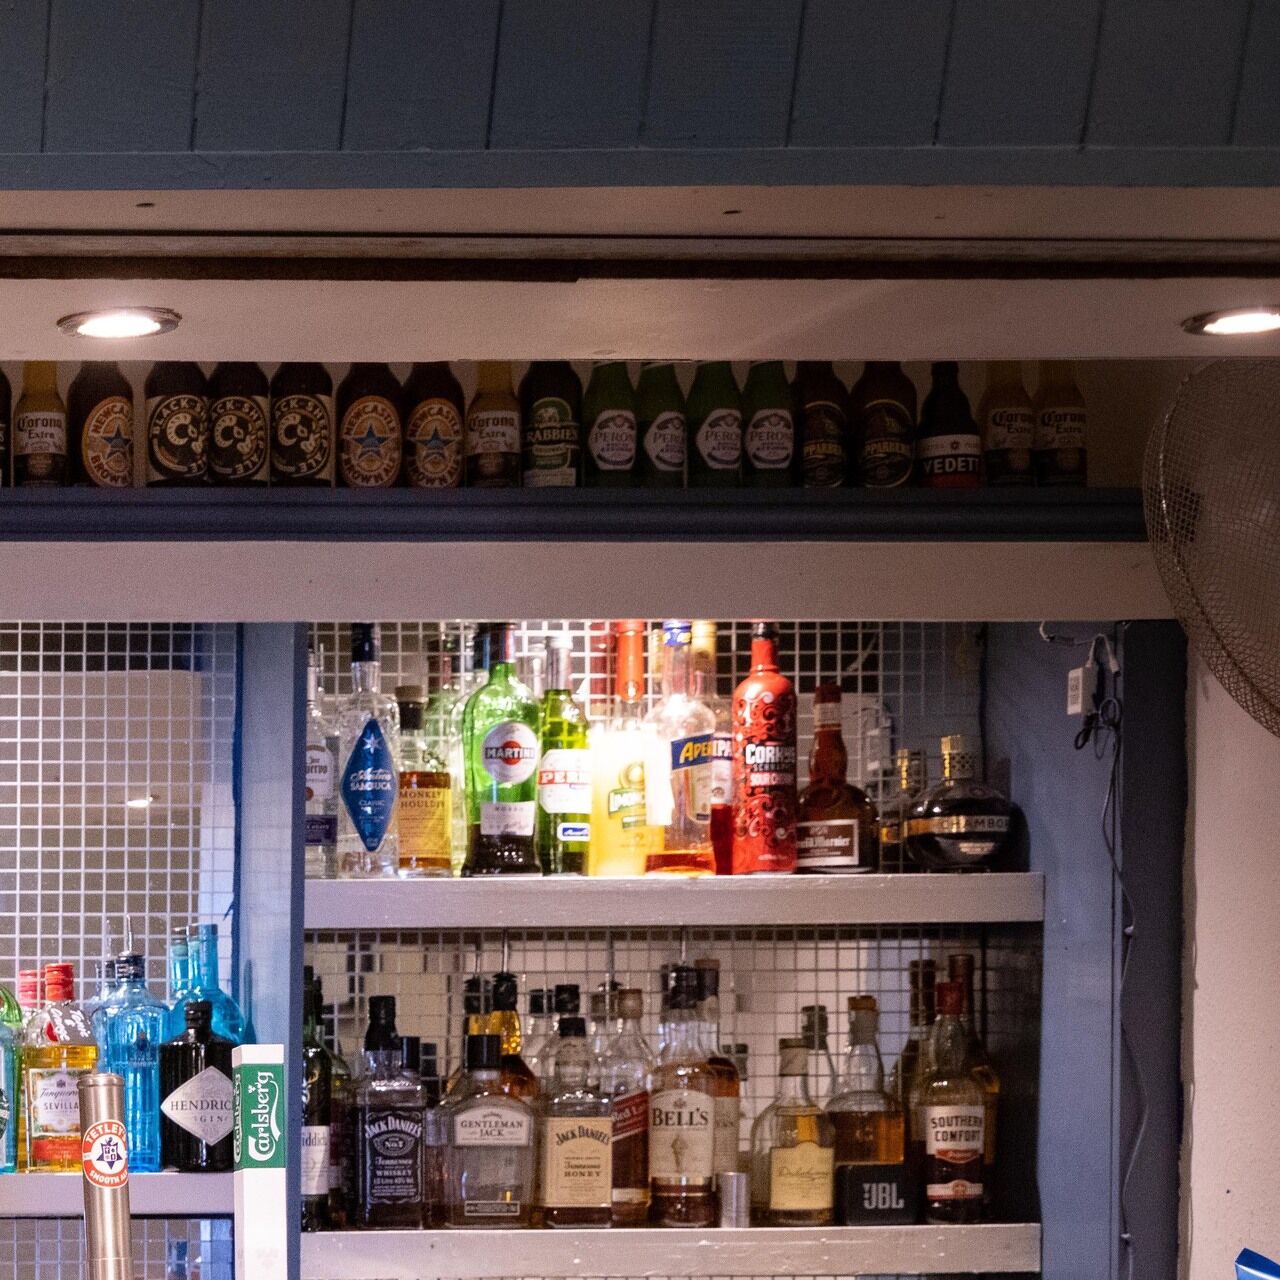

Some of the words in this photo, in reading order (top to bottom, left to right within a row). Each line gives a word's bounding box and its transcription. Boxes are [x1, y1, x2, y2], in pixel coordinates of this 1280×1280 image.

[344, 404, 397, 437] NEWCASTLE
[409, 405, 460, 438] NEWCASTLE
[485, 746, 535, 760] MARTINI
[248, 1071, 275, 1162] Carlsberg
[460, 1120, 524, 1129] GENTLEMAN
[652, 1106, 709, 1127] BELL'S
[364, 1120, 388, 1139] JACK
[387, 1116, 422, 1138] DANIEL'S
[480, 1129, 505, 1138] JACK
[934, 1129, 981, 1143] COMFORT
[556, 1130, 578, 1147] JACK
[89, 1169, 121, 1185] SMOOTH
[375, 1169, 413, 1177] WHISKEY
[862, 1182, 905, 1210] JBL
